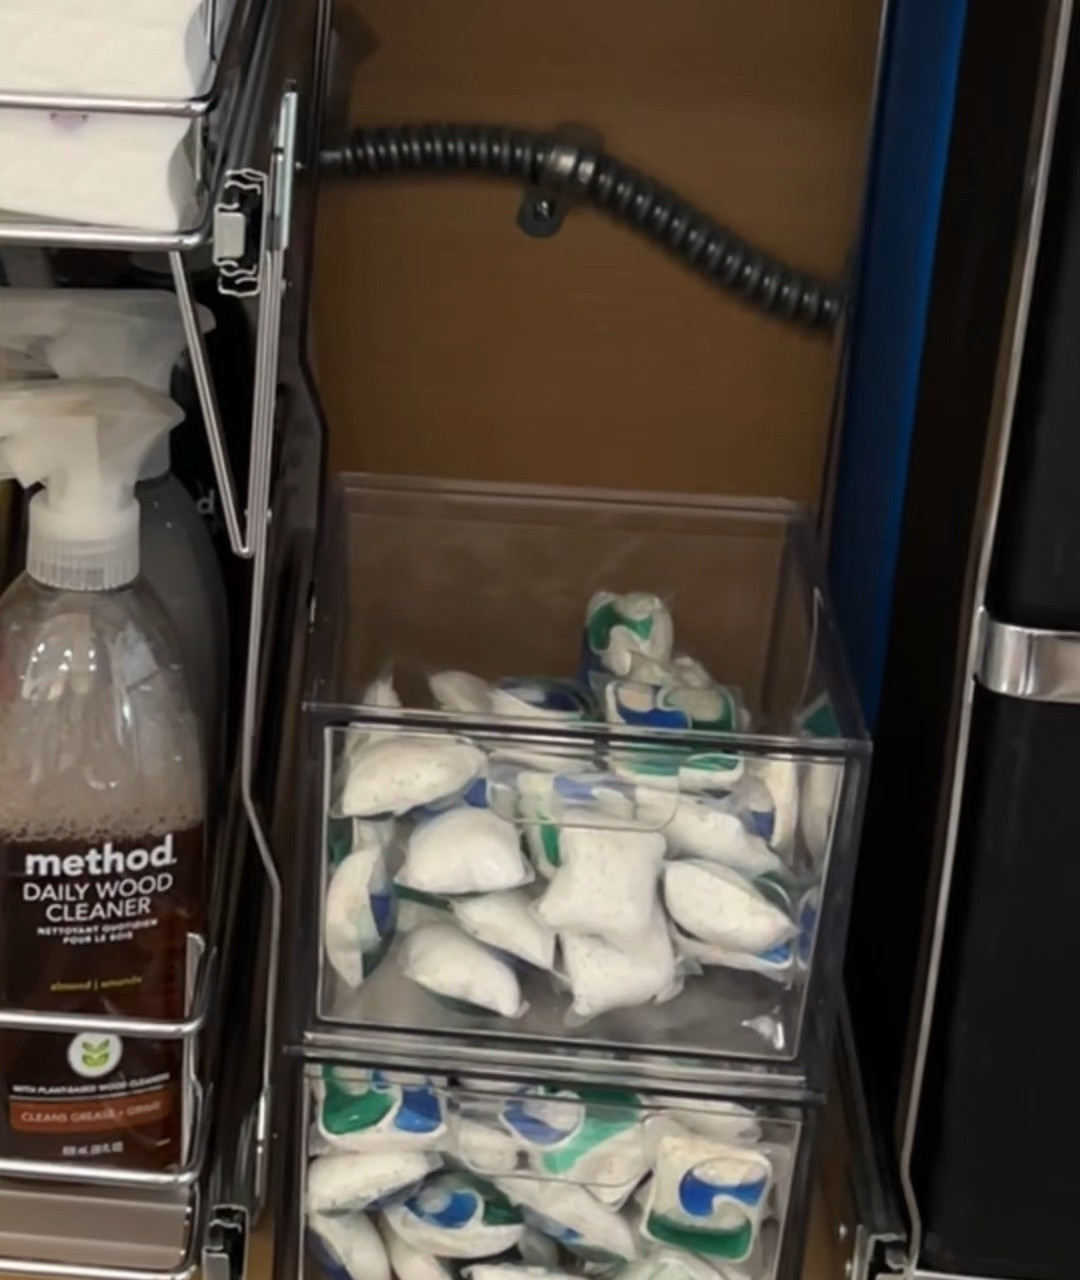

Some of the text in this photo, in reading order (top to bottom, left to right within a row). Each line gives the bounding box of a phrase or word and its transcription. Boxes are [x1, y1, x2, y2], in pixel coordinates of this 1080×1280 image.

[23, 873, 173, 902] DAILY WOOD
[45, 896, 151, 922] CLEANER
[37, 924, 99, 936] NETTOYANT
[63, 934, 92, 945] POUR
[94, 933, 106, 944] LE
[50, 979, 92, 992] almond
[21, 1110, 68, 1122] CLEANS
[70, 1108, 117, 1123] GREASE
